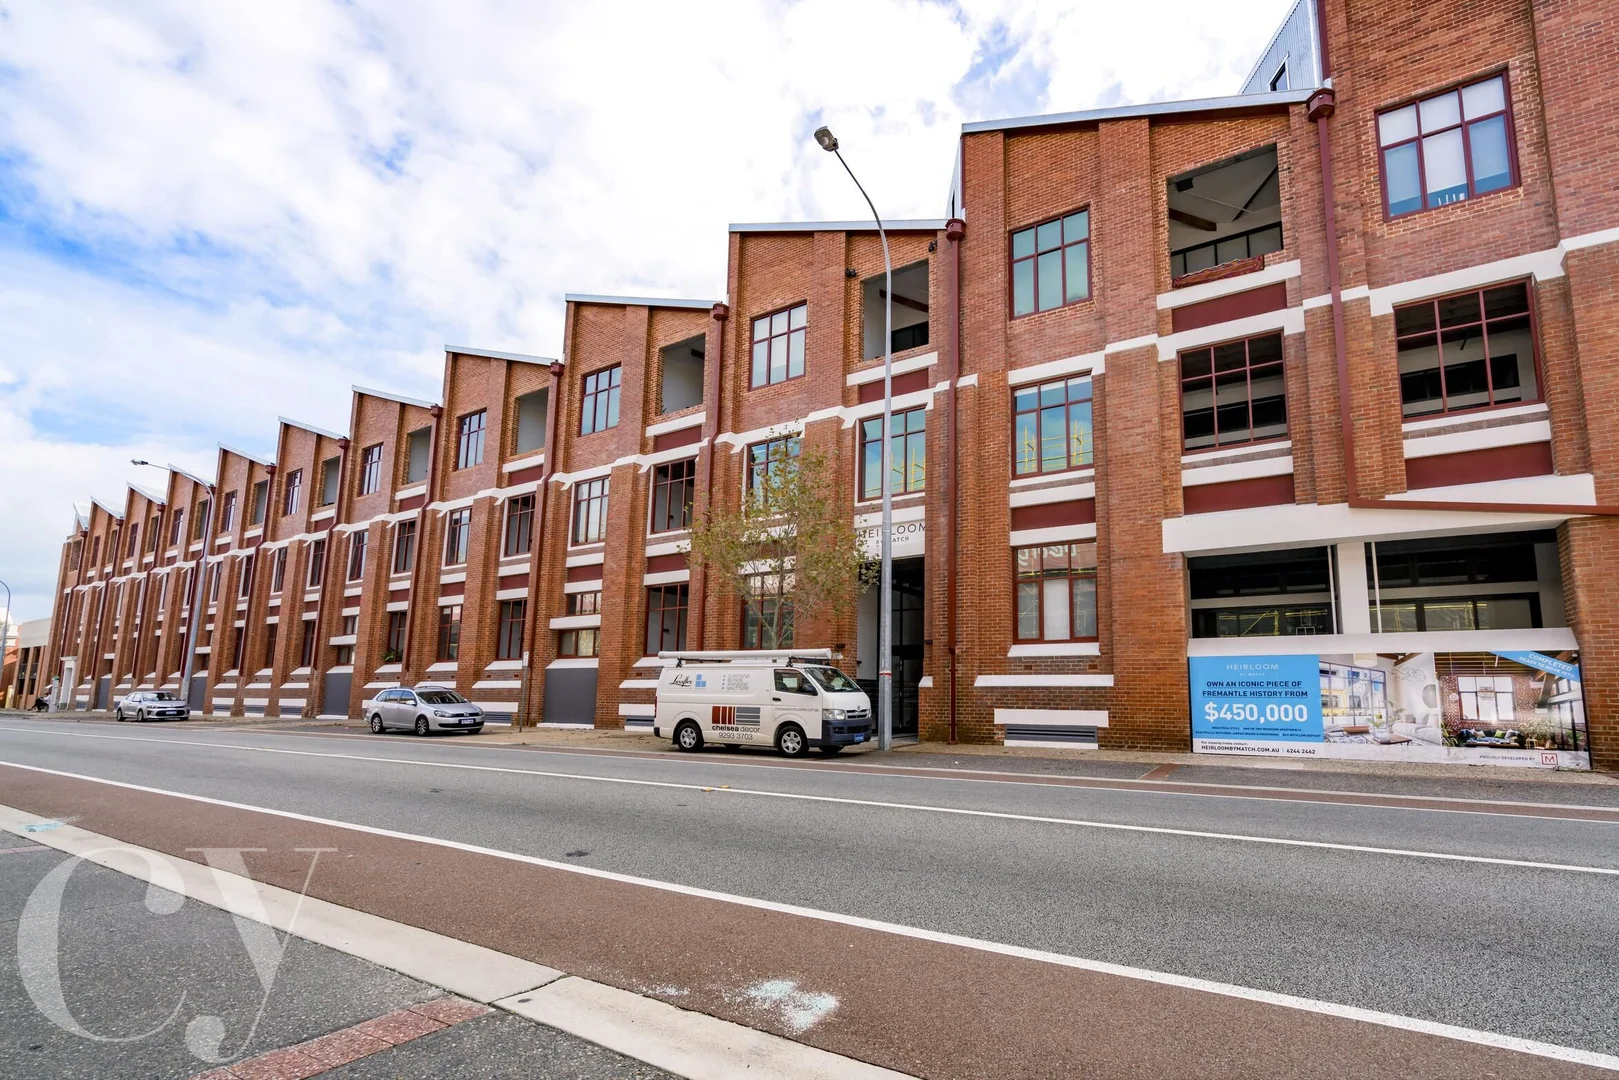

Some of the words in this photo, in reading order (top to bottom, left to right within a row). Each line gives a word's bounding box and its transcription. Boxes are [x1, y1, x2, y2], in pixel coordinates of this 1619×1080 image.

[1518, 656, 1537, 665] READY
[1545, 665, 1561, 673] MOVE
[1561, 670, 1575, 678] INTO
[1528, 653, 1573, 671] COMPLETED
[1206, 680, 1224, 688] OWN
[1226, 680, 1237, 688] AN
[1238, 680, 1265, 688] ICONIC
[1266, 680, 1290, 688] PIECE
[1291, 680, 1302, 688] OF
[1204, 701, 1308, 724] $450,000
[711, 724, 739, 732] chelsea
[1201, 745, 1280, 753] HEIRLOOMBYMATCH.COM.AU
